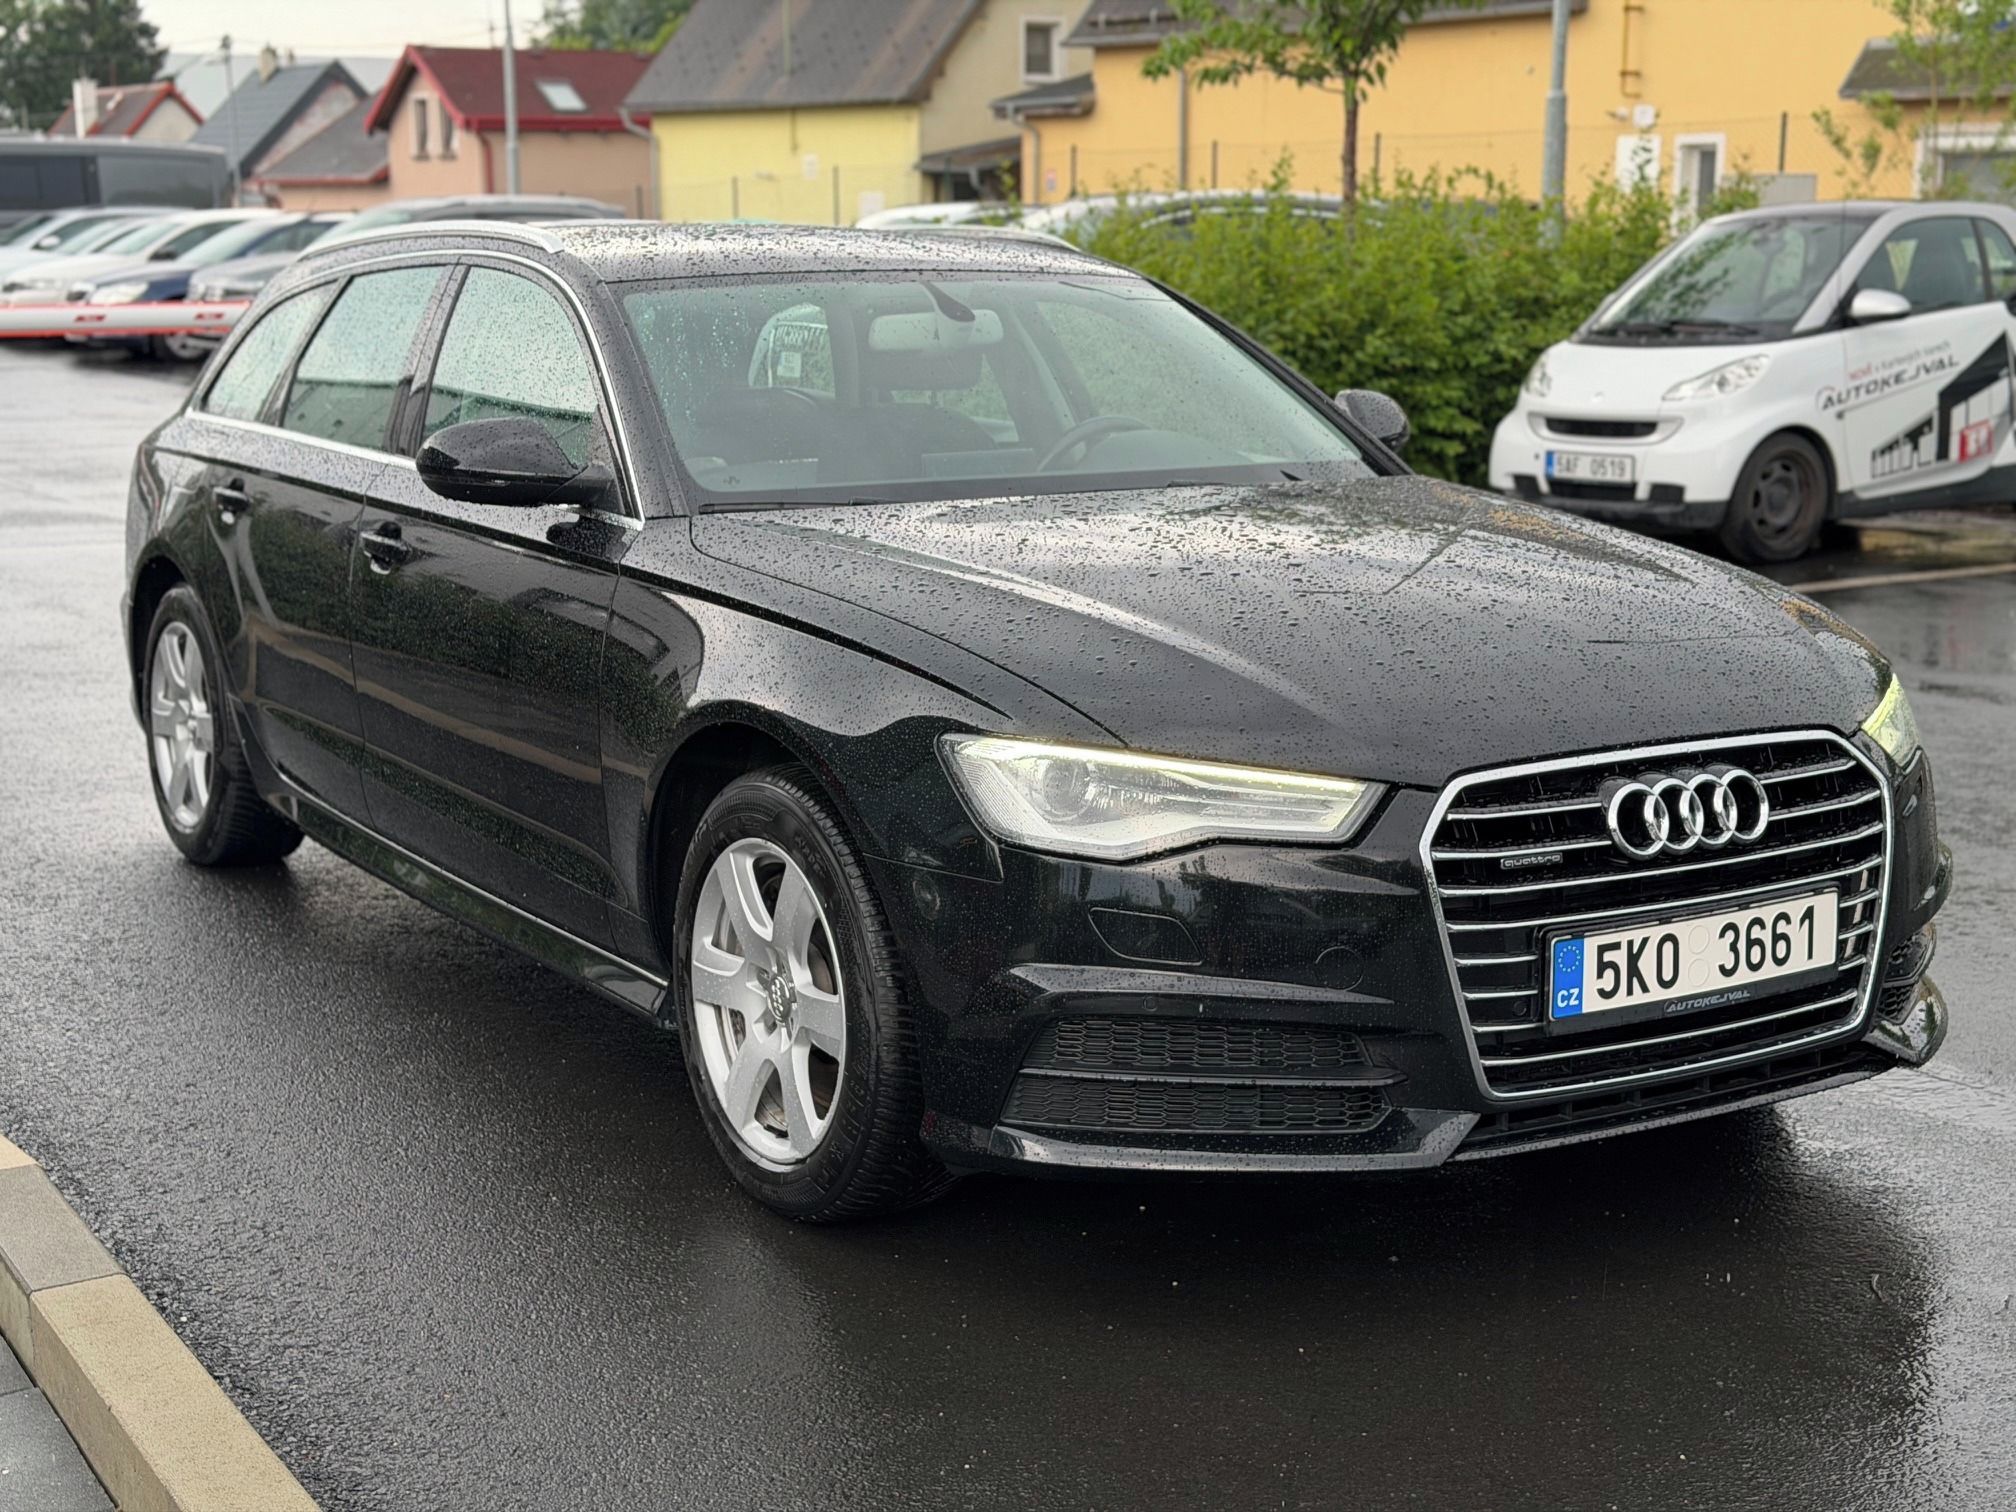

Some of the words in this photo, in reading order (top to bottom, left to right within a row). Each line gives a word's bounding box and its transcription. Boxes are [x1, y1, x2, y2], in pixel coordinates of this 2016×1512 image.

[1822, 353, 1960, 411] AUTOKEJVAL
[1504, 854, 1561, 868] quattro
[1596, 932, 1680, 1000] 5K0
[1718, 904, 1815, 978] 3661
[1556, 987, 1580, 1008] CZ
[1665, 989, 1751, 1013] AUTOKEJVAL
